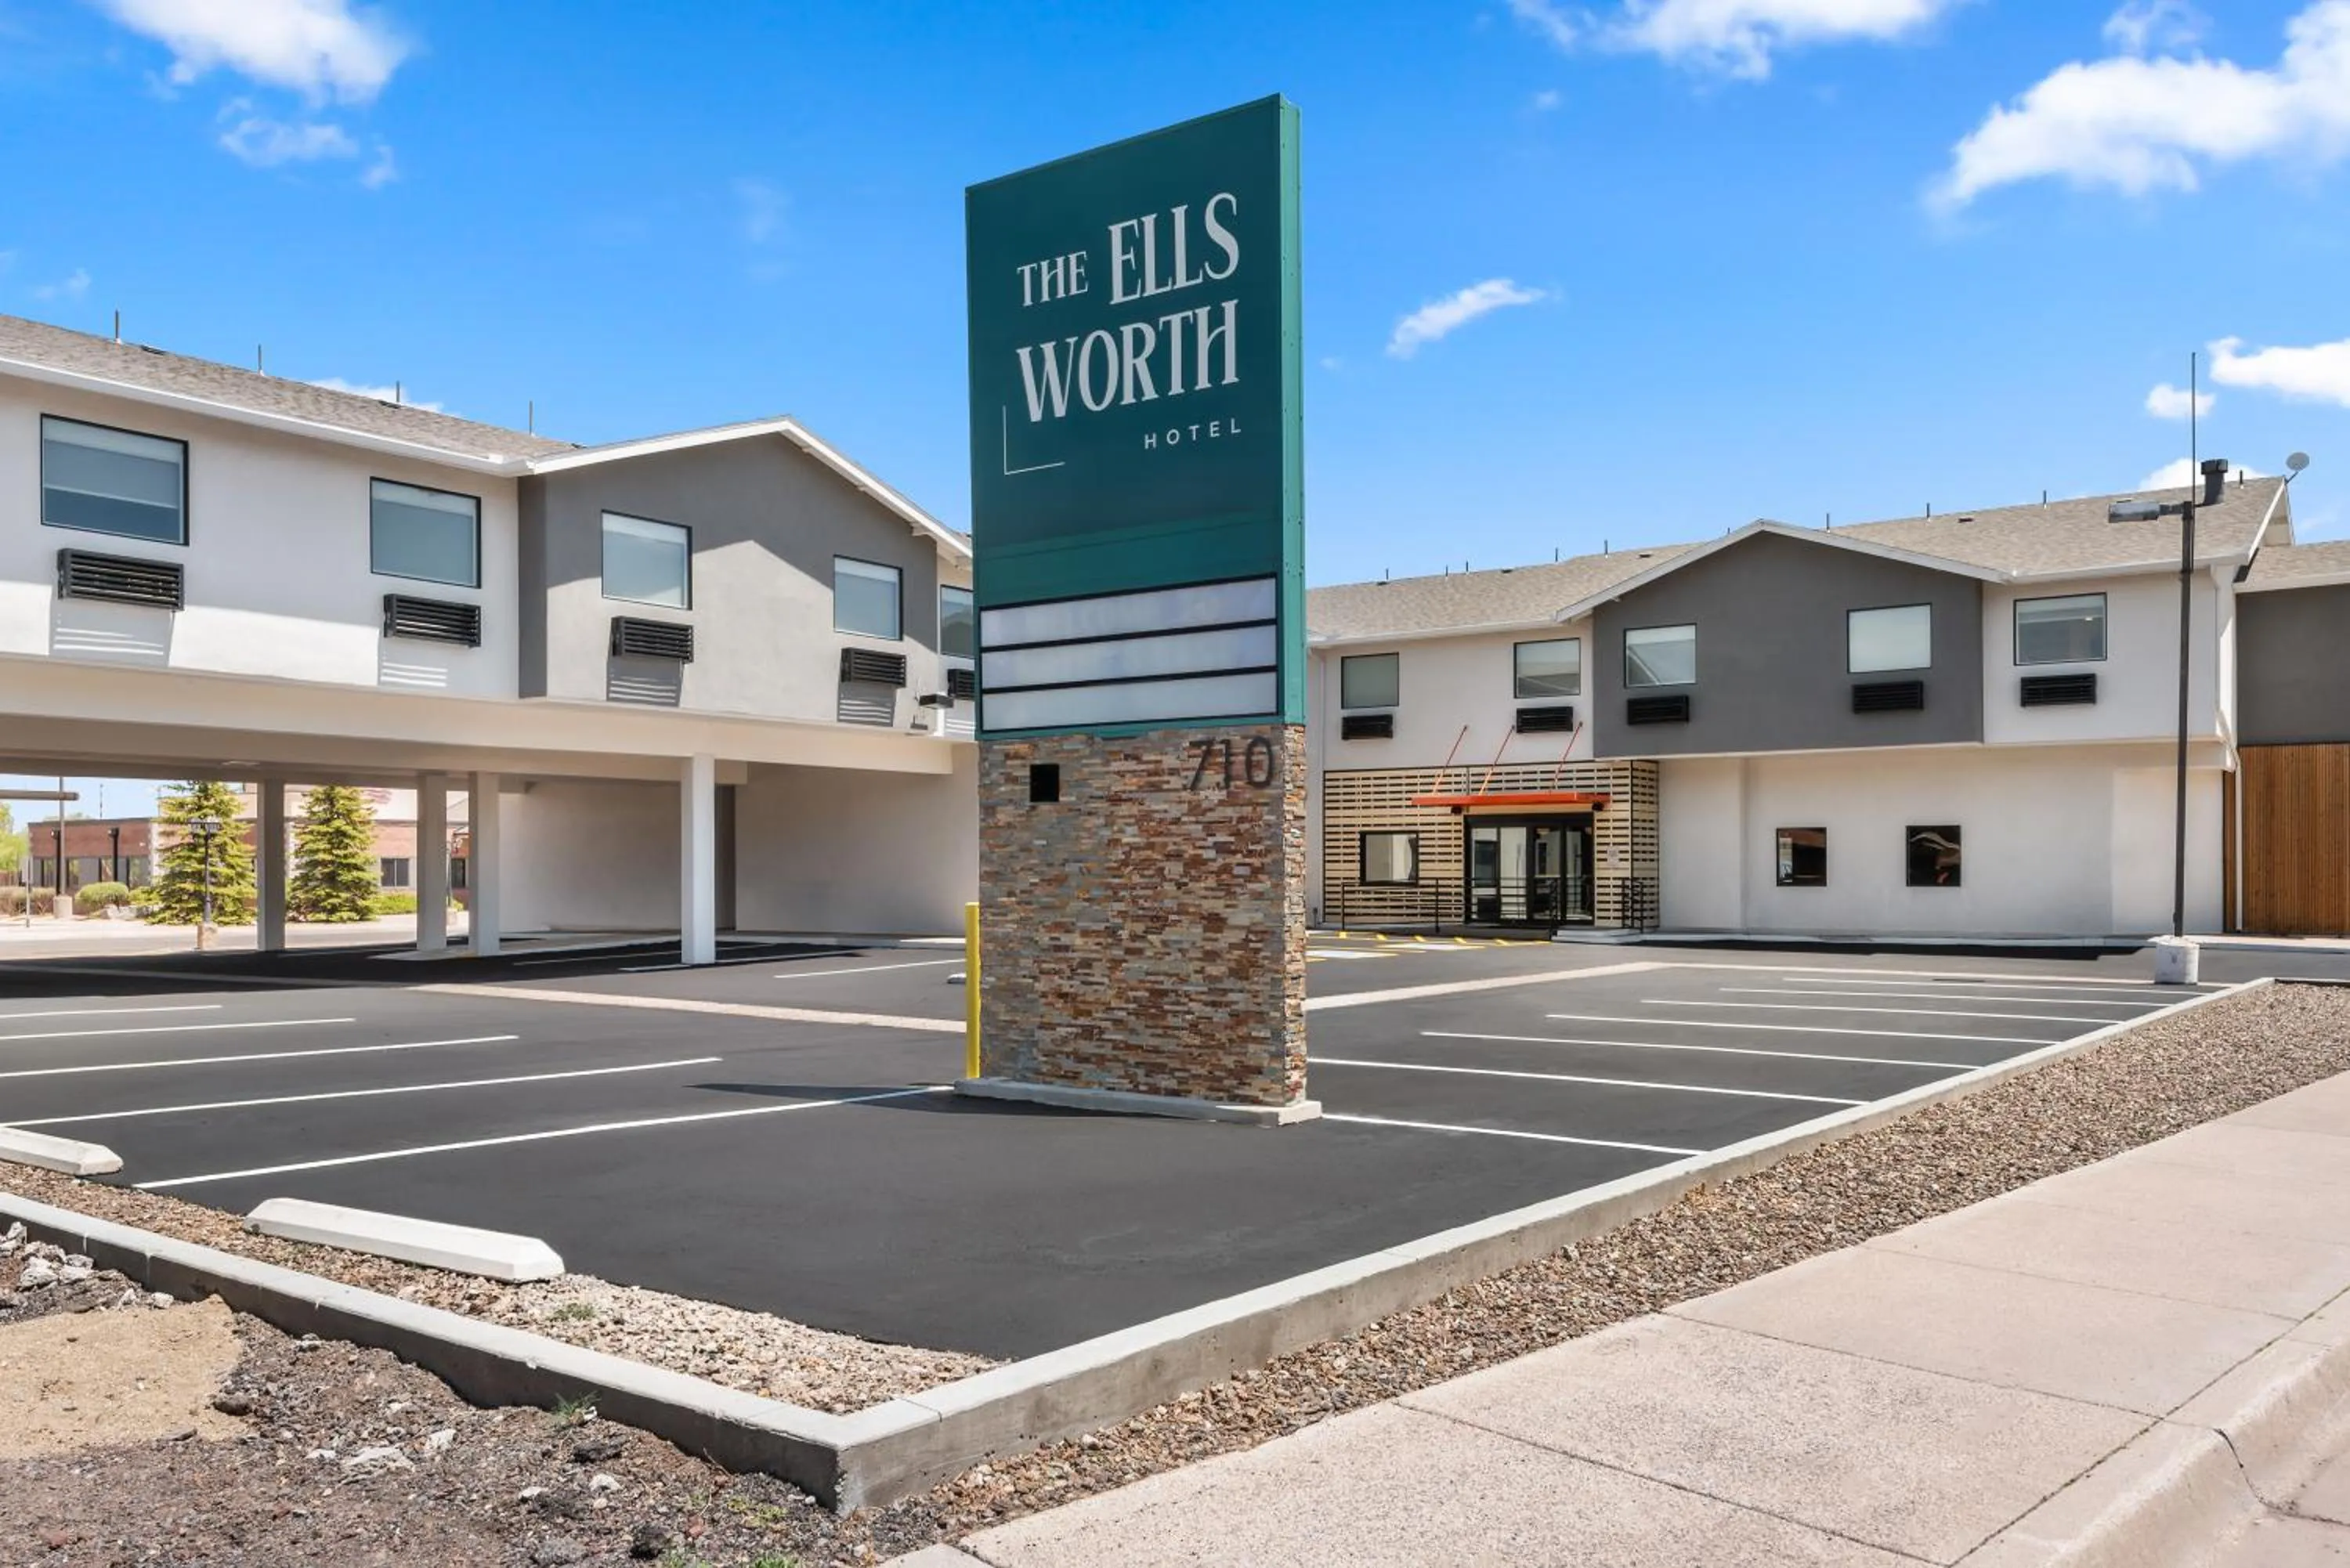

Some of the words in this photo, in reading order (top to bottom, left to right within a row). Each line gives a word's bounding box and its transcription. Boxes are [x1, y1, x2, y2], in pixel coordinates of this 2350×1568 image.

[1017, 251, 1088, 306] THE
[1108, 193, 1239, 304] ELLS
[1016, 299, 1239, 422] WORTH
[1144, 418, 1242, 450] HOTEL
[1188, 735, 1274, 791] 710
